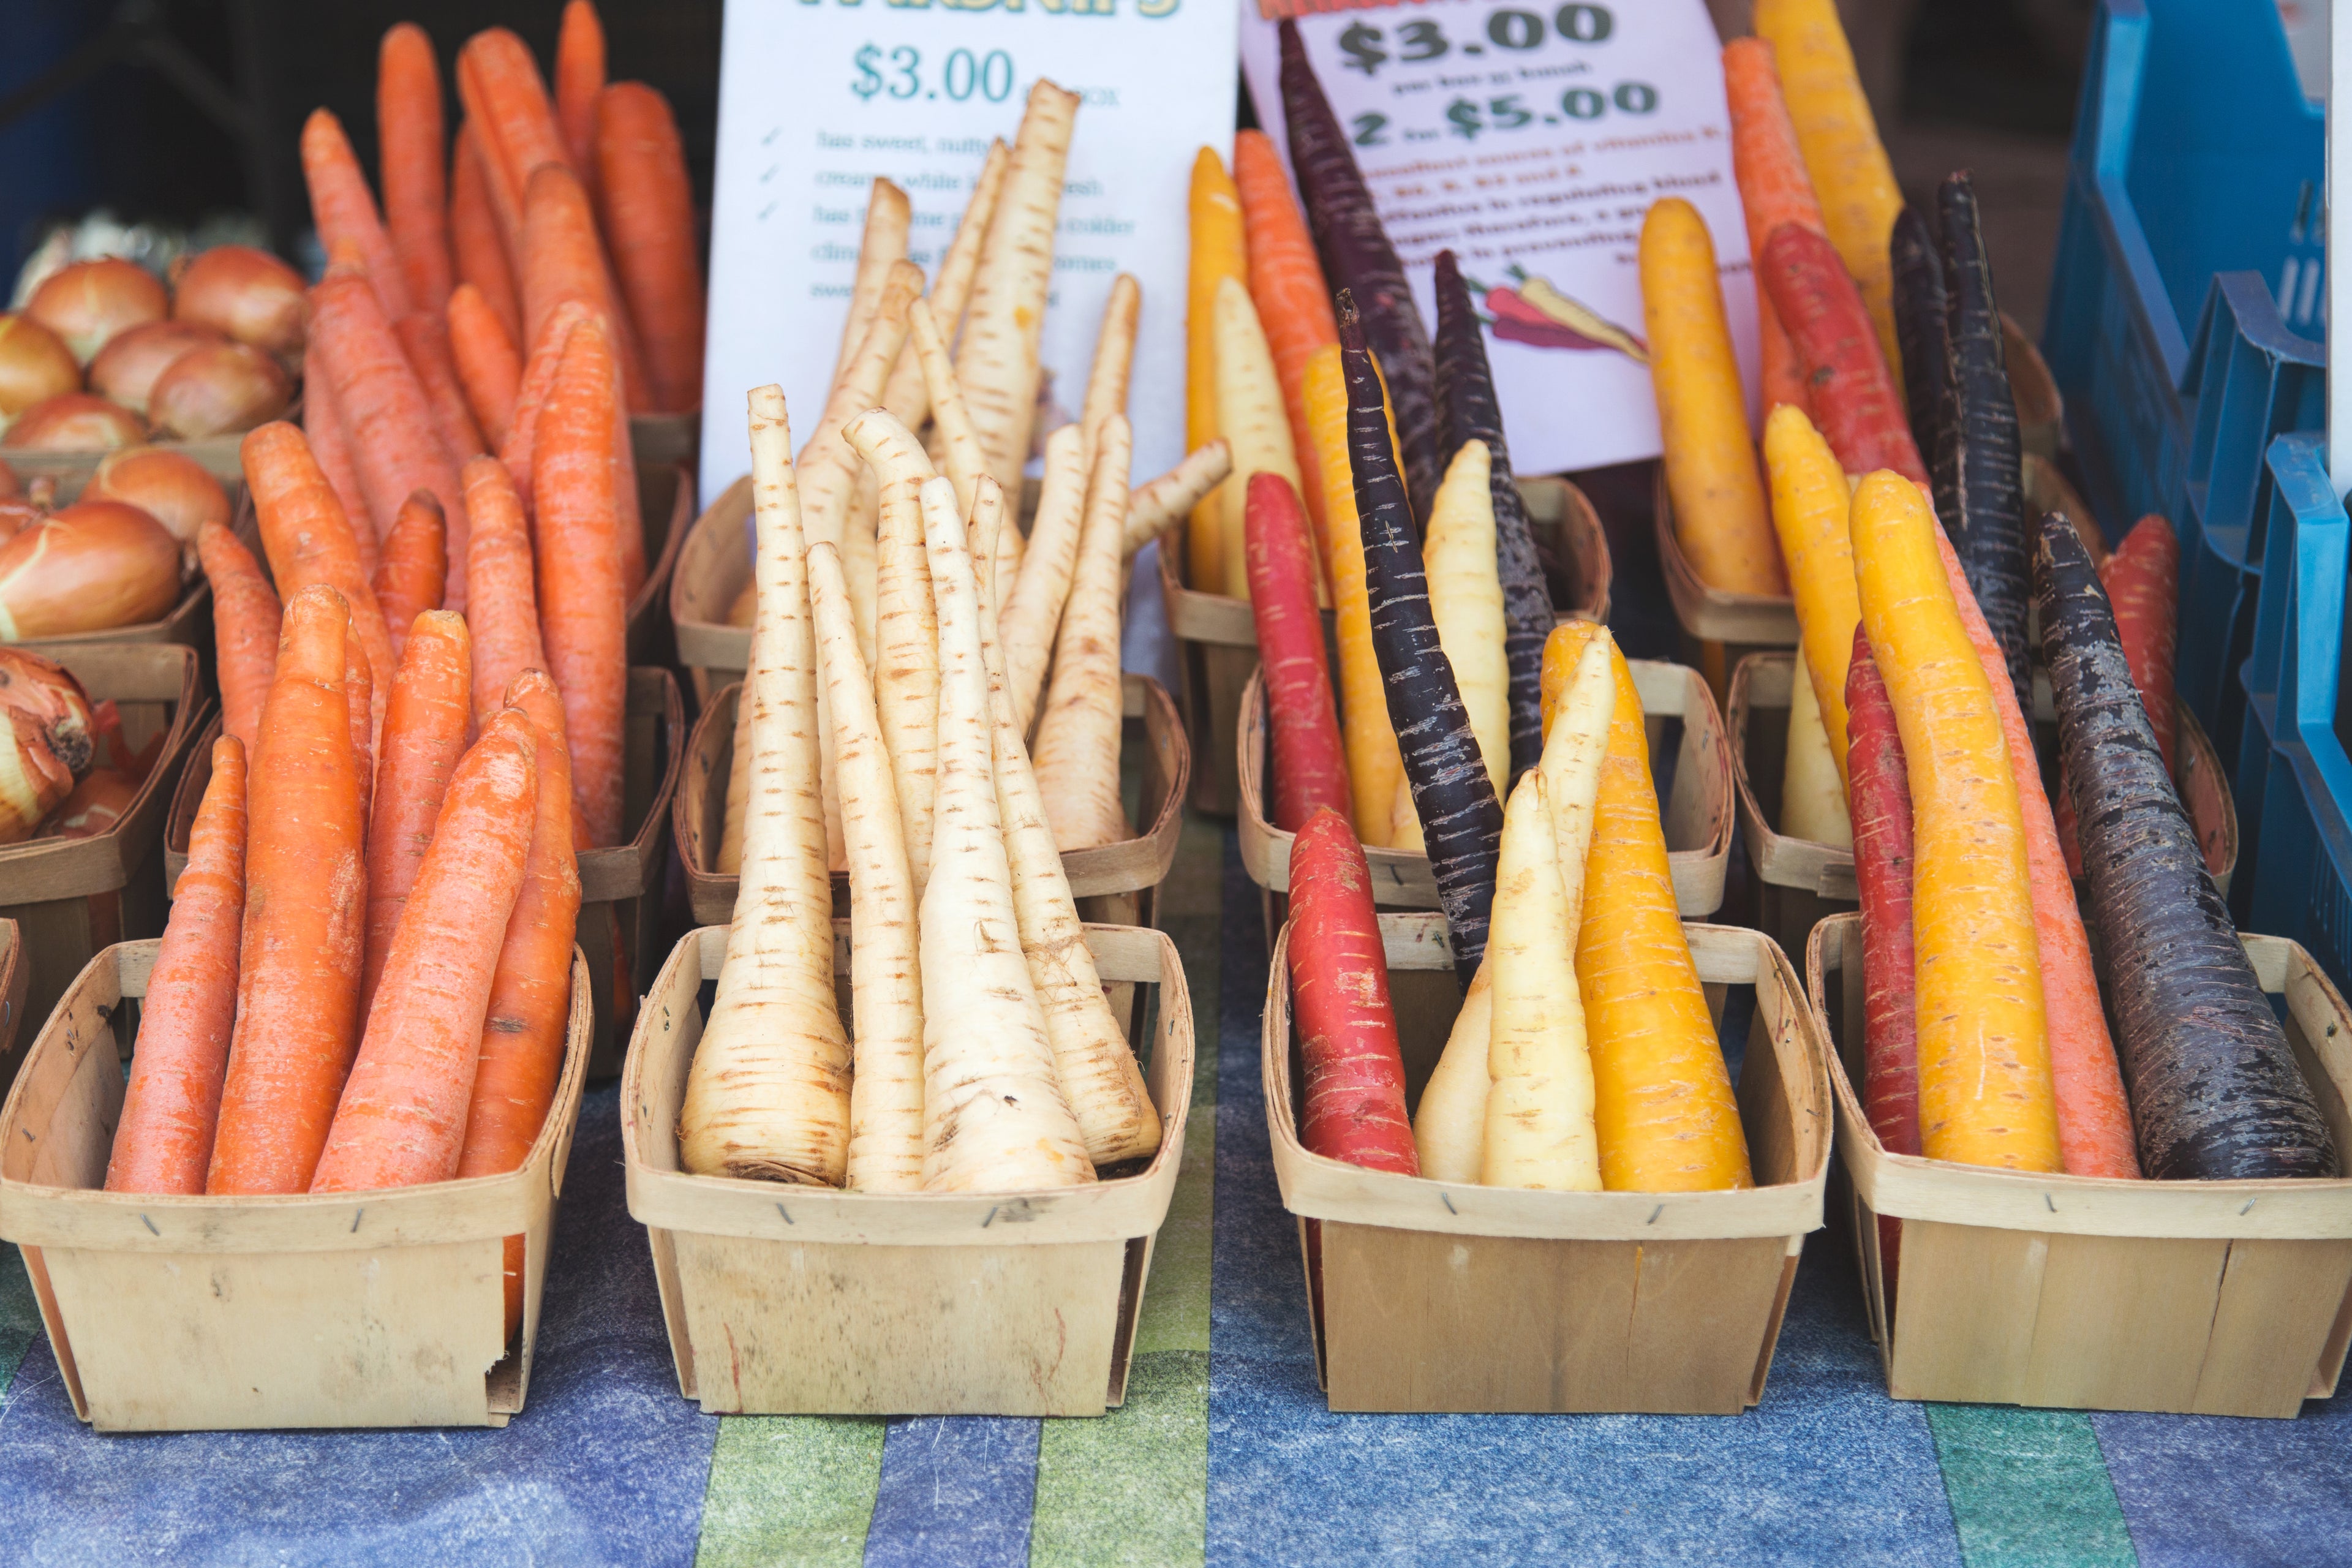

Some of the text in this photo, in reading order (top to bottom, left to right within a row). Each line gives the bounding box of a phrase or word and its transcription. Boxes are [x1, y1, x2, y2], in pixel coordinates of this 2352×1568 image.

[1338, 4, 1613, 76] $3.00
[850, 42, 1014, 103] $3.00
[1351, 112, 1387, 145] 2
[1446, 82, 1657, 140] $5.00
